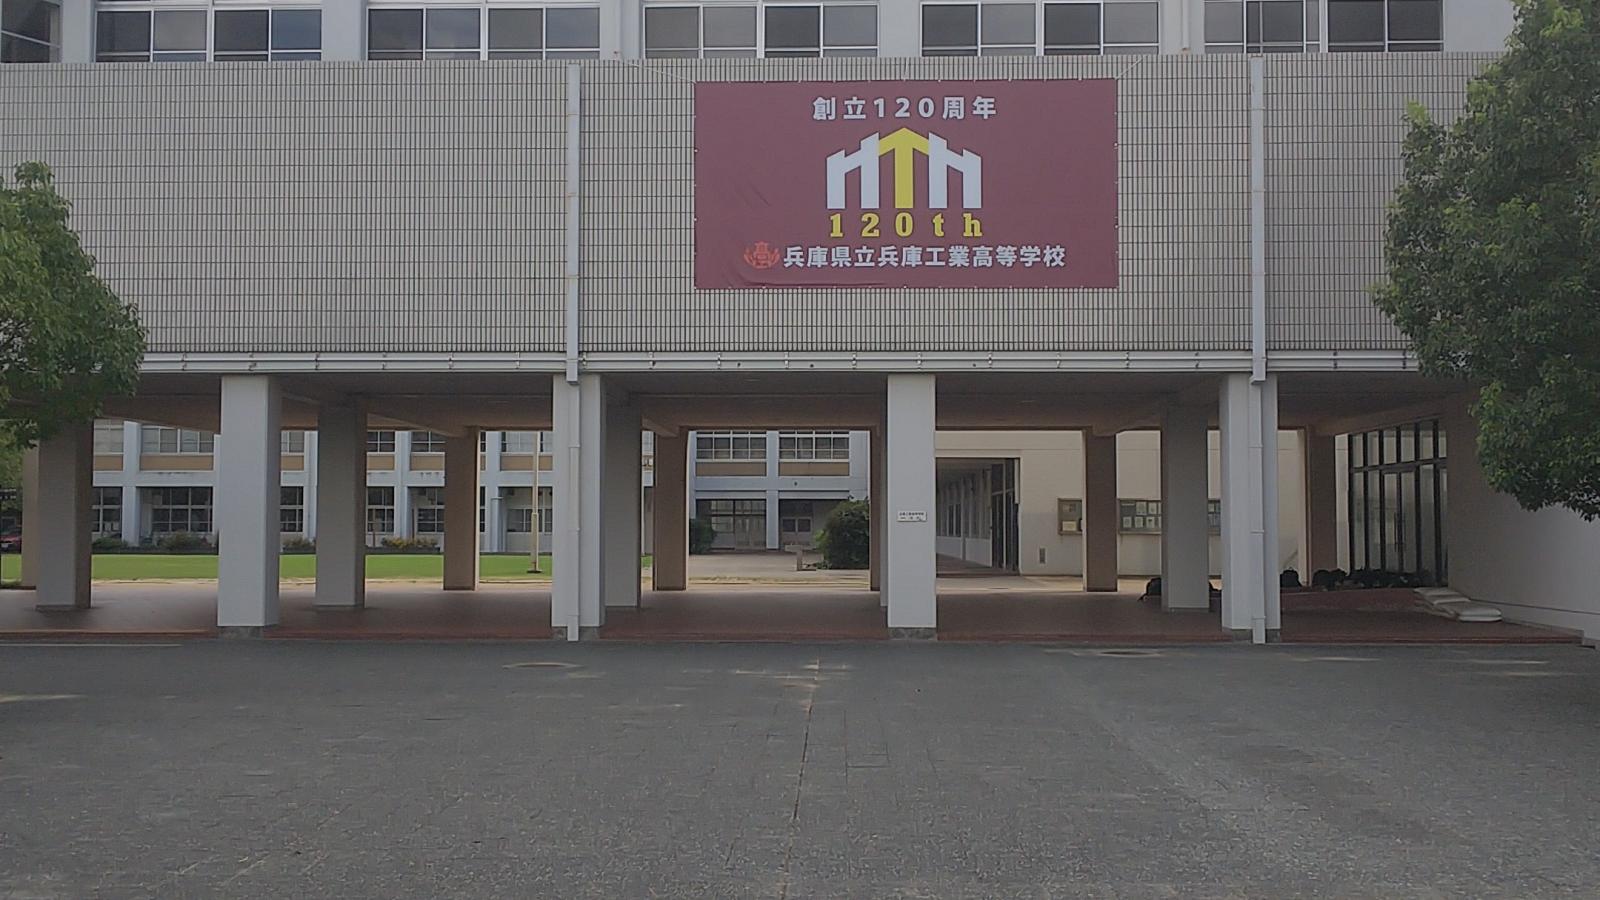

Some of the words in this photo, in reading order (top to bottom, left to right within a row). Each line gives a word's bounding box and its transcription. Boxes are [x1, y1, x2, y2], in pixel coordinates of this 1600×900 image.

[813, 96, 997, 120] 創立120周年
[829, 212, 982, 237] 120th
[783, 245, 1065, 268] 兵庫県立兵庫工業高等学校
